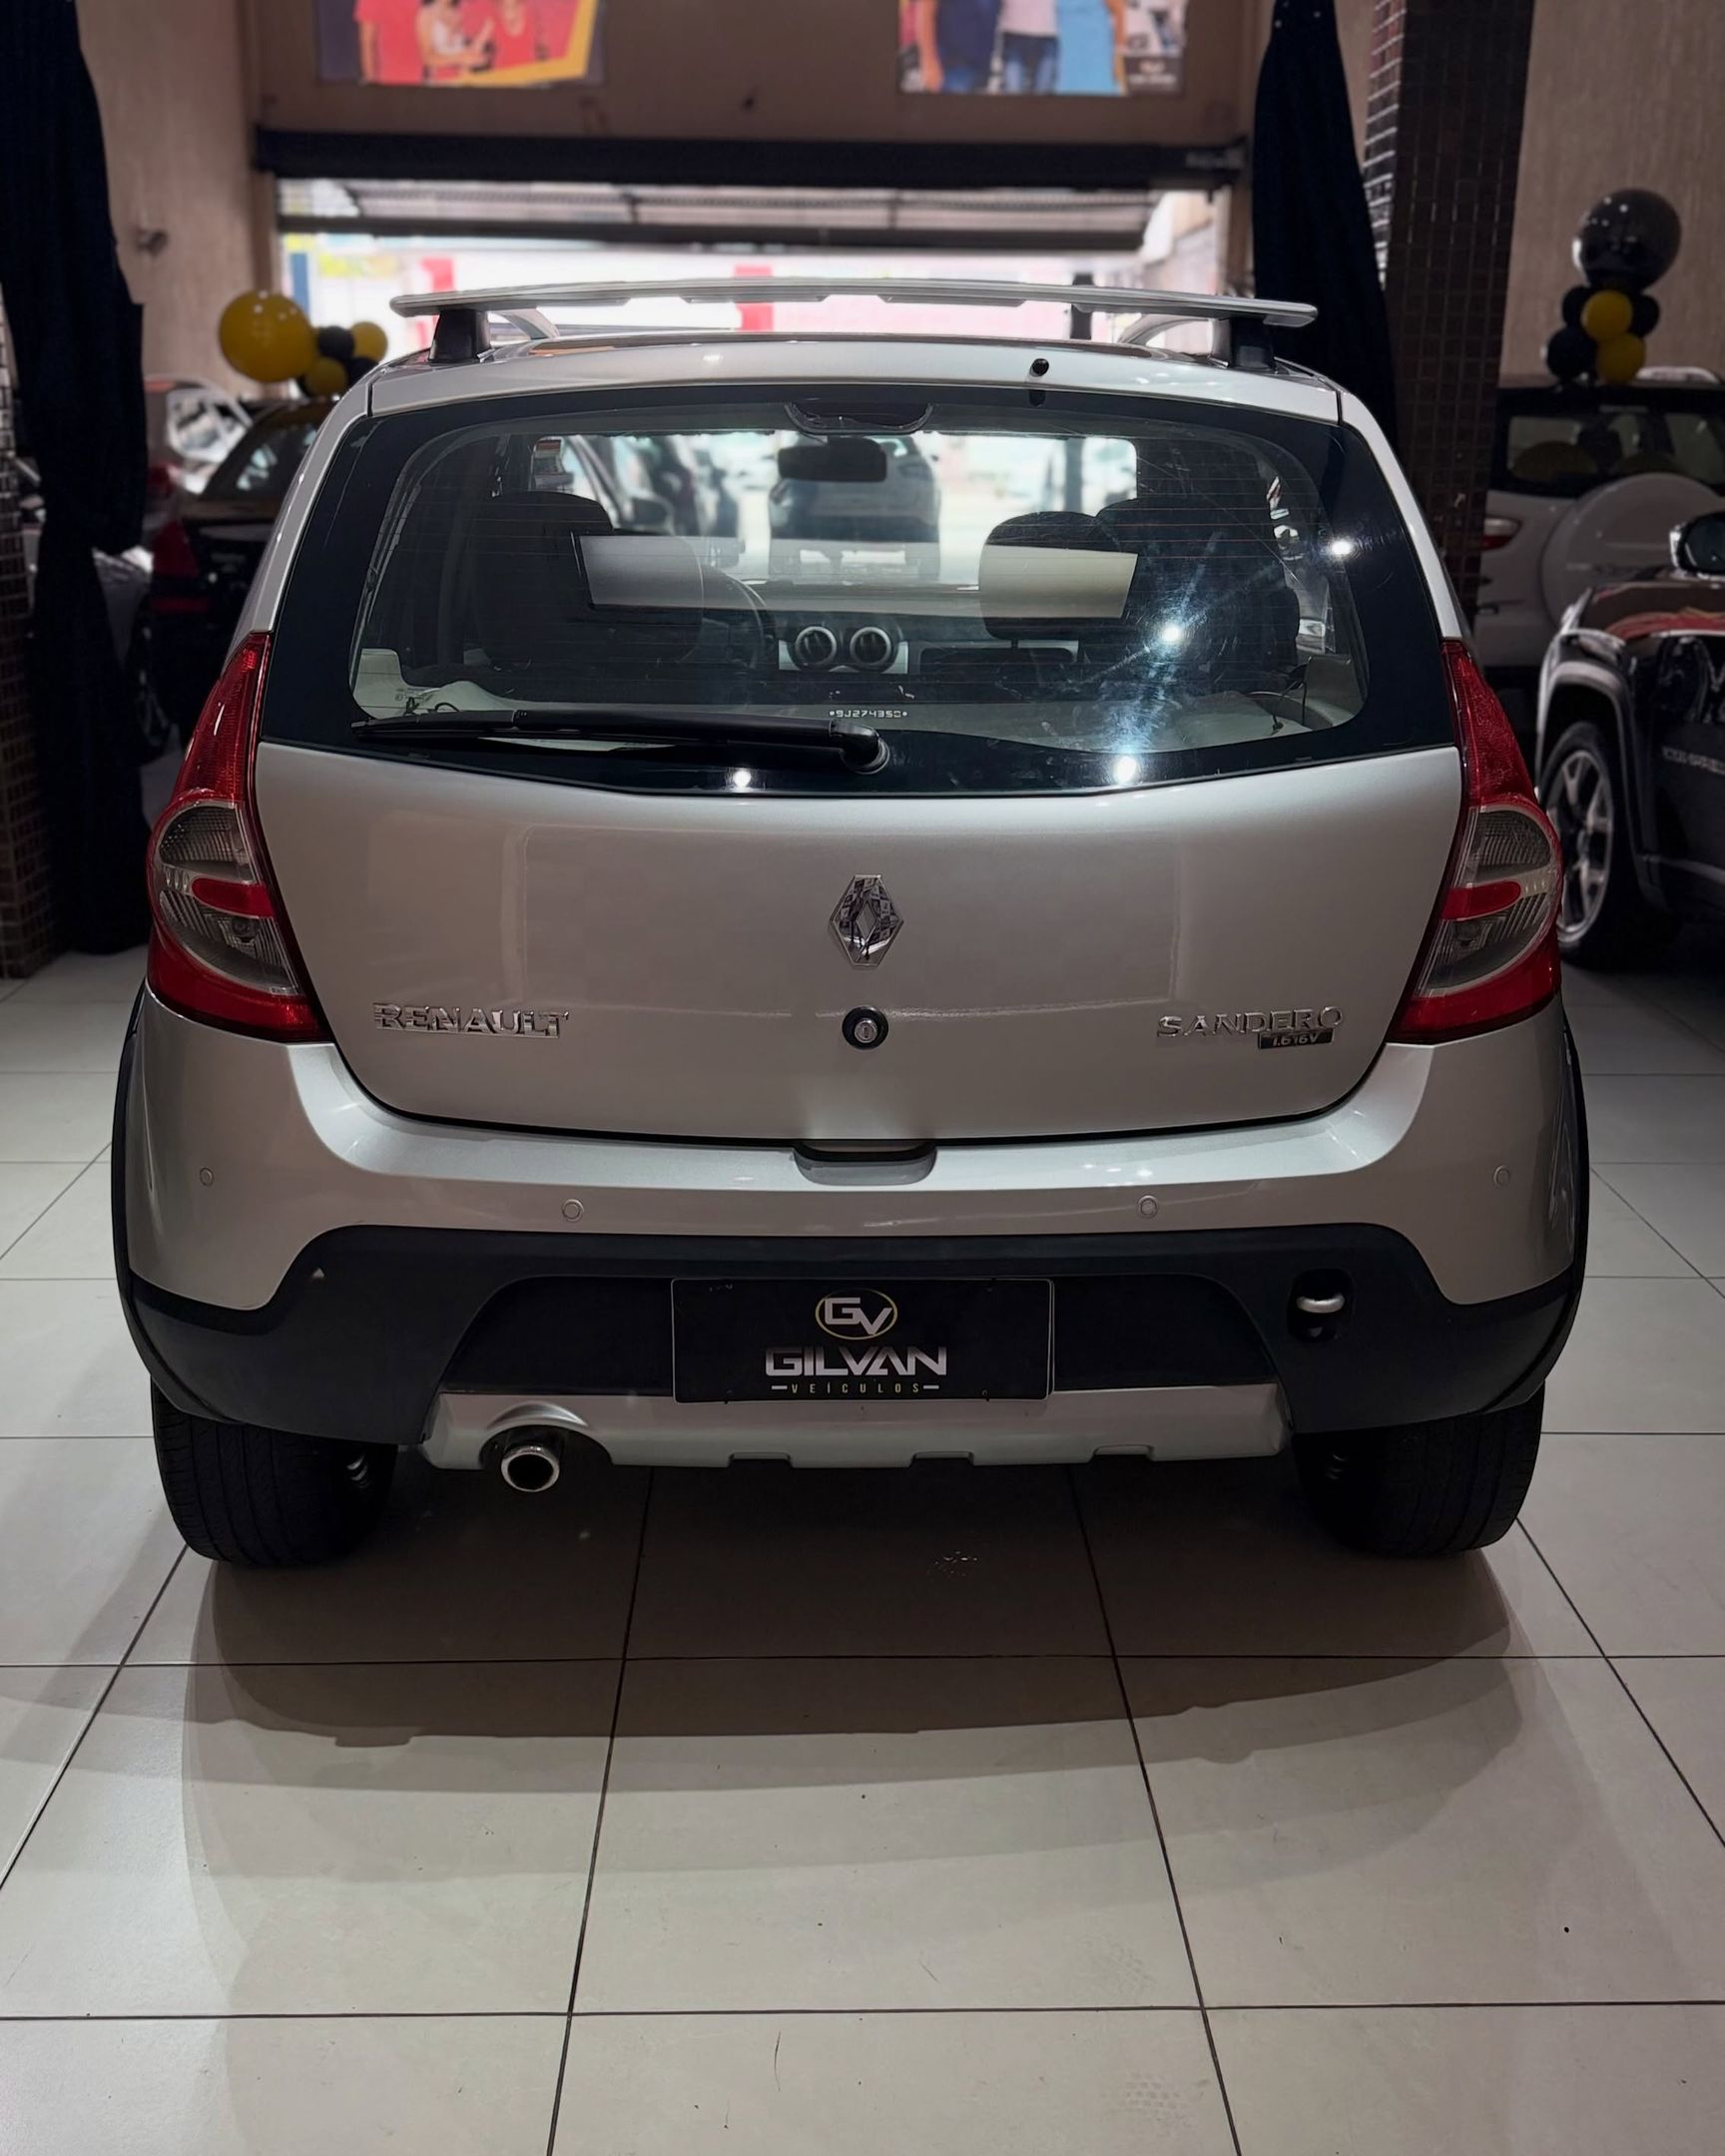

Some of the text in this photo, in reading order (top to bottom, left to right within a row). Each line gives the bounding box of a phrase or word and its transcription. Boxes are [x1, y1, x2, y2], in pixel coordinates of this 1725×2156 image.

[372, 1002, 569, 1038] RENAULT
[1158, 1006, 1343, 1037] SANDERO
[825, 1297, 893, 1335] GV
[765, 1348, 947, 1376] GILVAN
